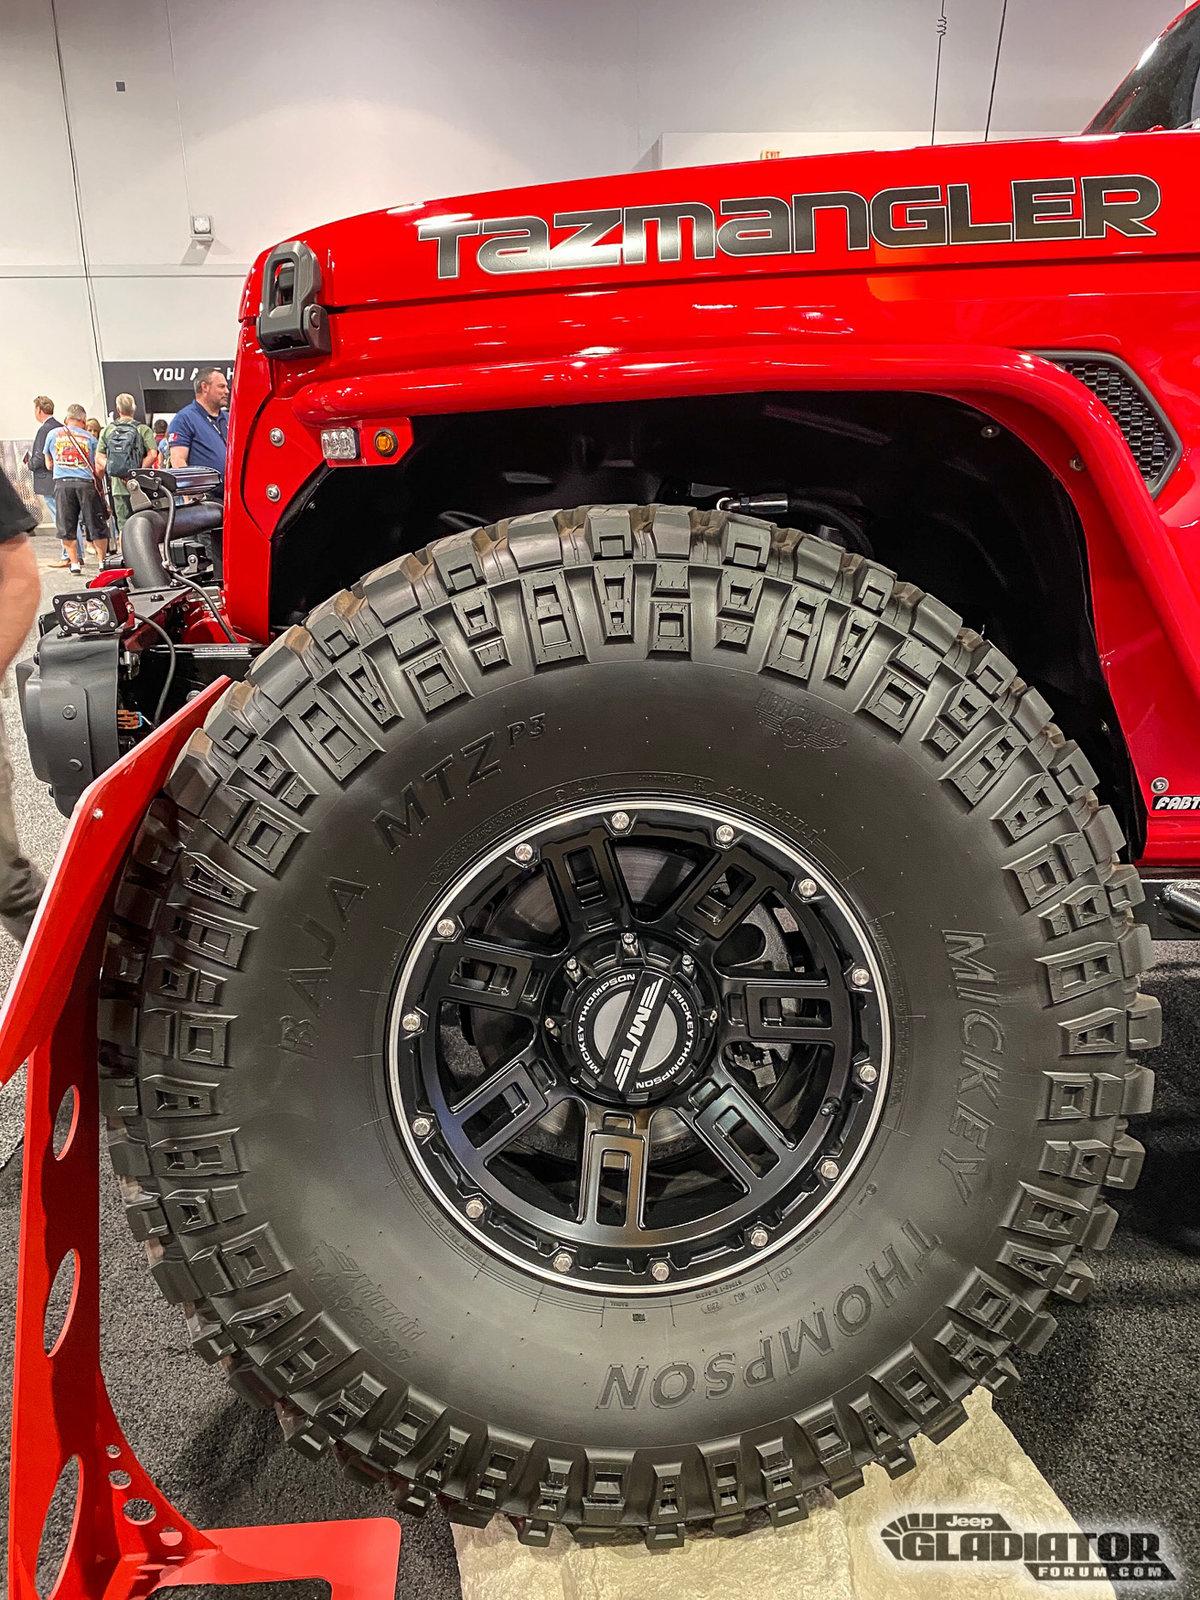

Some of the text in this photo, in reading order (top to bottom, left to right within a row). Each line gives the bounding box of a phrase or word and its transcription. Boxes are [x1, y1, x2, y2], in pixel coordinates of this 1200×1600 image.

[153, 368, 184, 381] YOU
[1155, 796, 1200, 810] FABT
[278, 875, 370, 1058] BAJA
[372, 731, 502, 854] MTZ
[506, 712, 547, 748] P3
[577, 973, 636, 1075] MICKEY THOMPSON
[636, 988, 694, 1090] MICKEY THOMPSON
[596, 929, 1005, 1410] MICKEY THOMPSON
